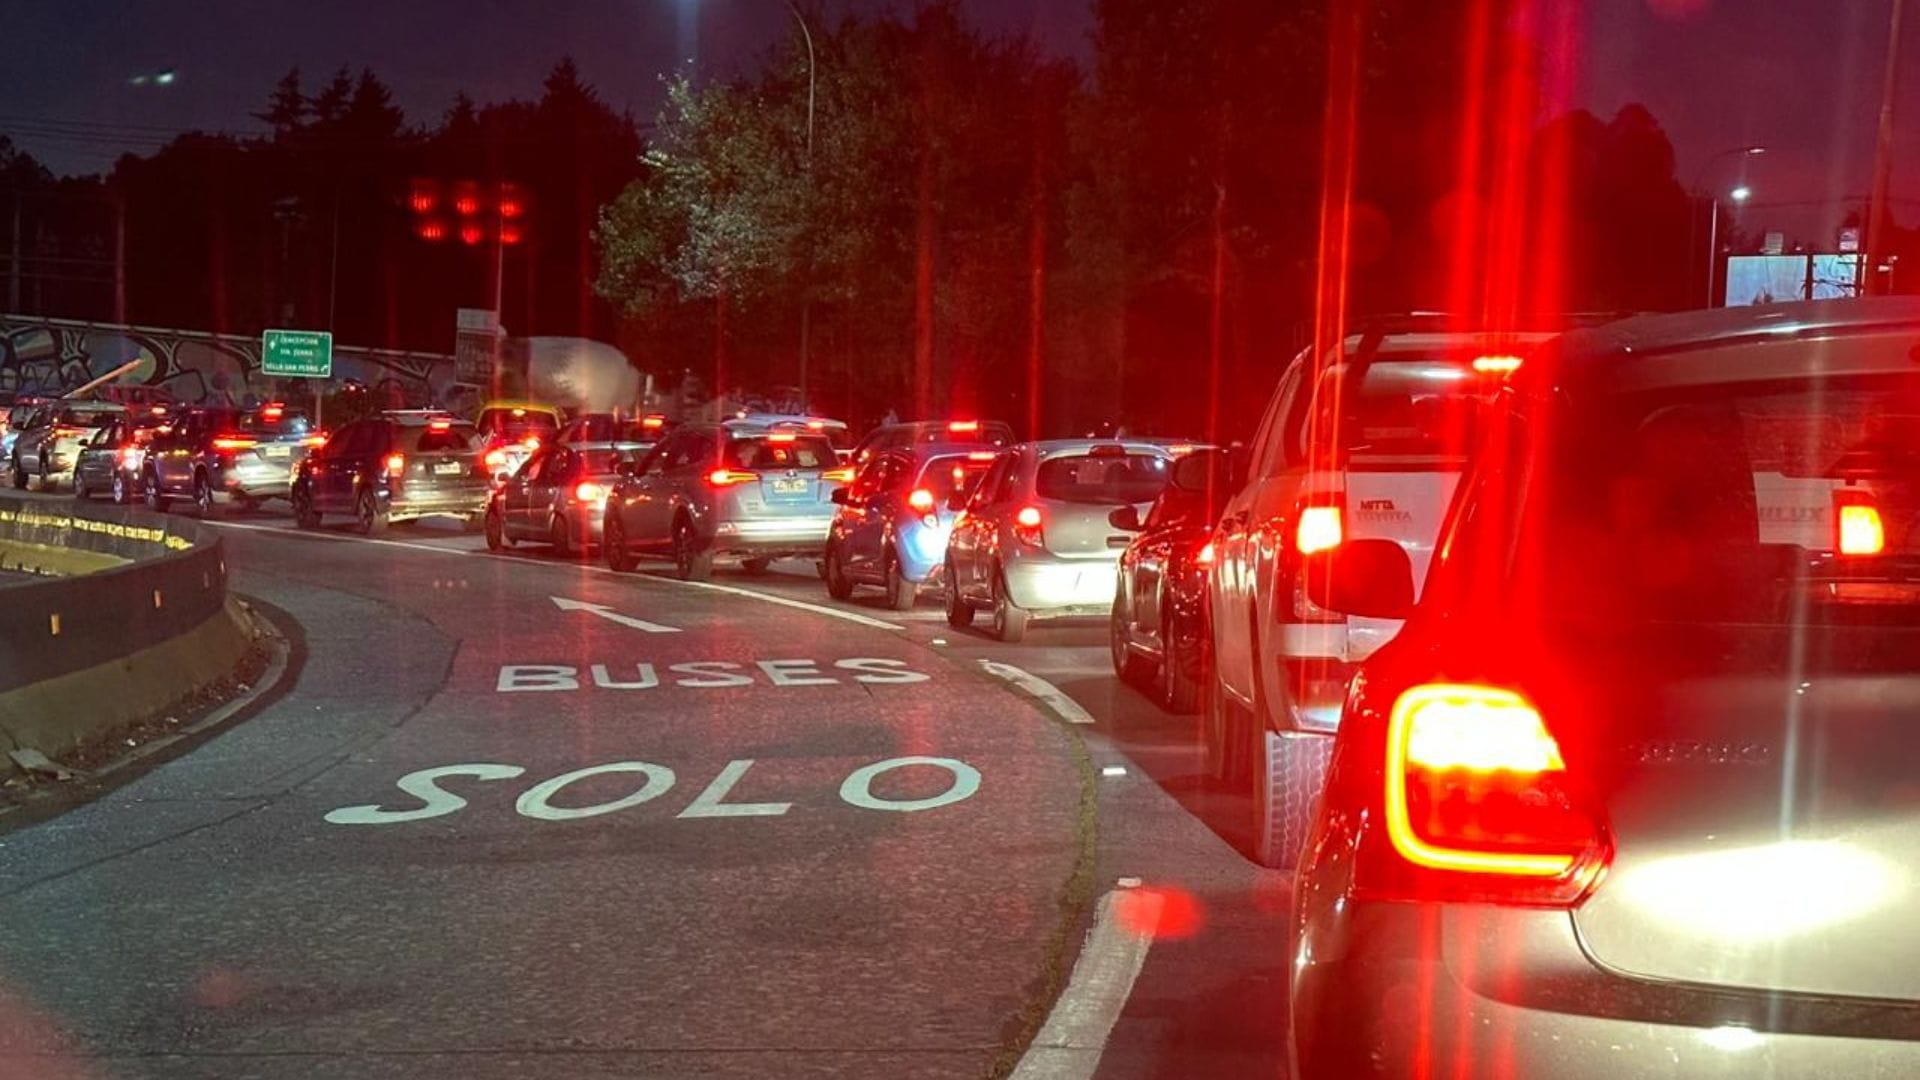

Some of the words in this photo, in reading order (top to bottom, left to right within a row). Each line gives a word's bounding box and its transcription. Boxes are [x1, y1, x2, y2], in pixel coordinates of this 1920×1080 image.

[1360, 500, 1394, 510] MITTA
[496, 657, 930, 692] BUSES
[323, 755, 982, 825] SOLO
